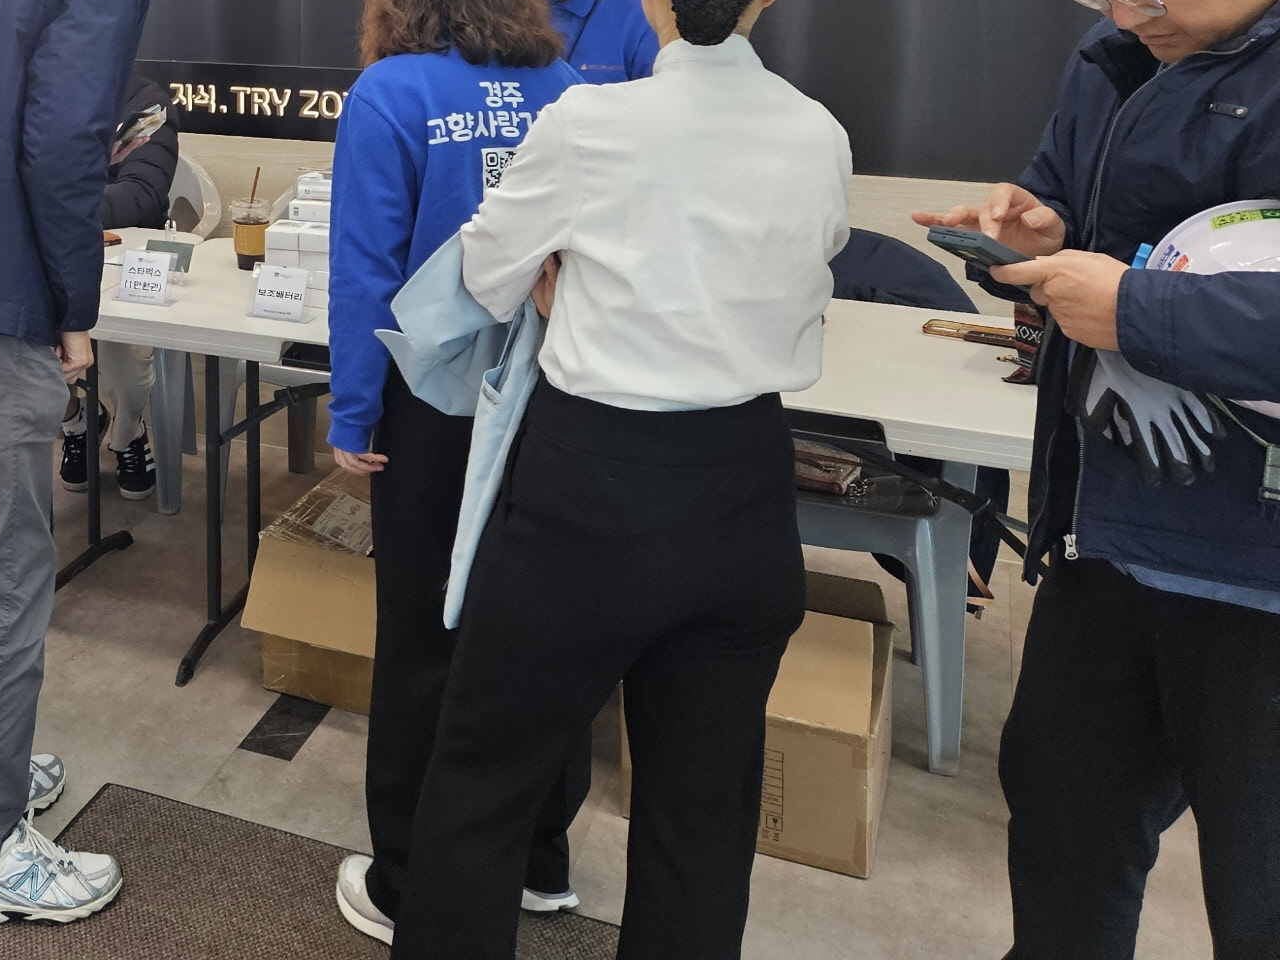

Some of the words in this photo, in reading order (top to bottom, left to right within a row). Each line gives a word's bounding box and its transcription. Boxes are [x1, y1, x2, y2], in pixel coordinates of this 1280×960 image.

[169, 82, 227, 114] 지식.
[230, 86, 291, 117] TRY
[298, 89, 348, 120] ZO
[478, 81, 524, 109] 경주
[128, 266, 162, 277] 스타벅스
[257, 288, 303, 302] 보조배터리
